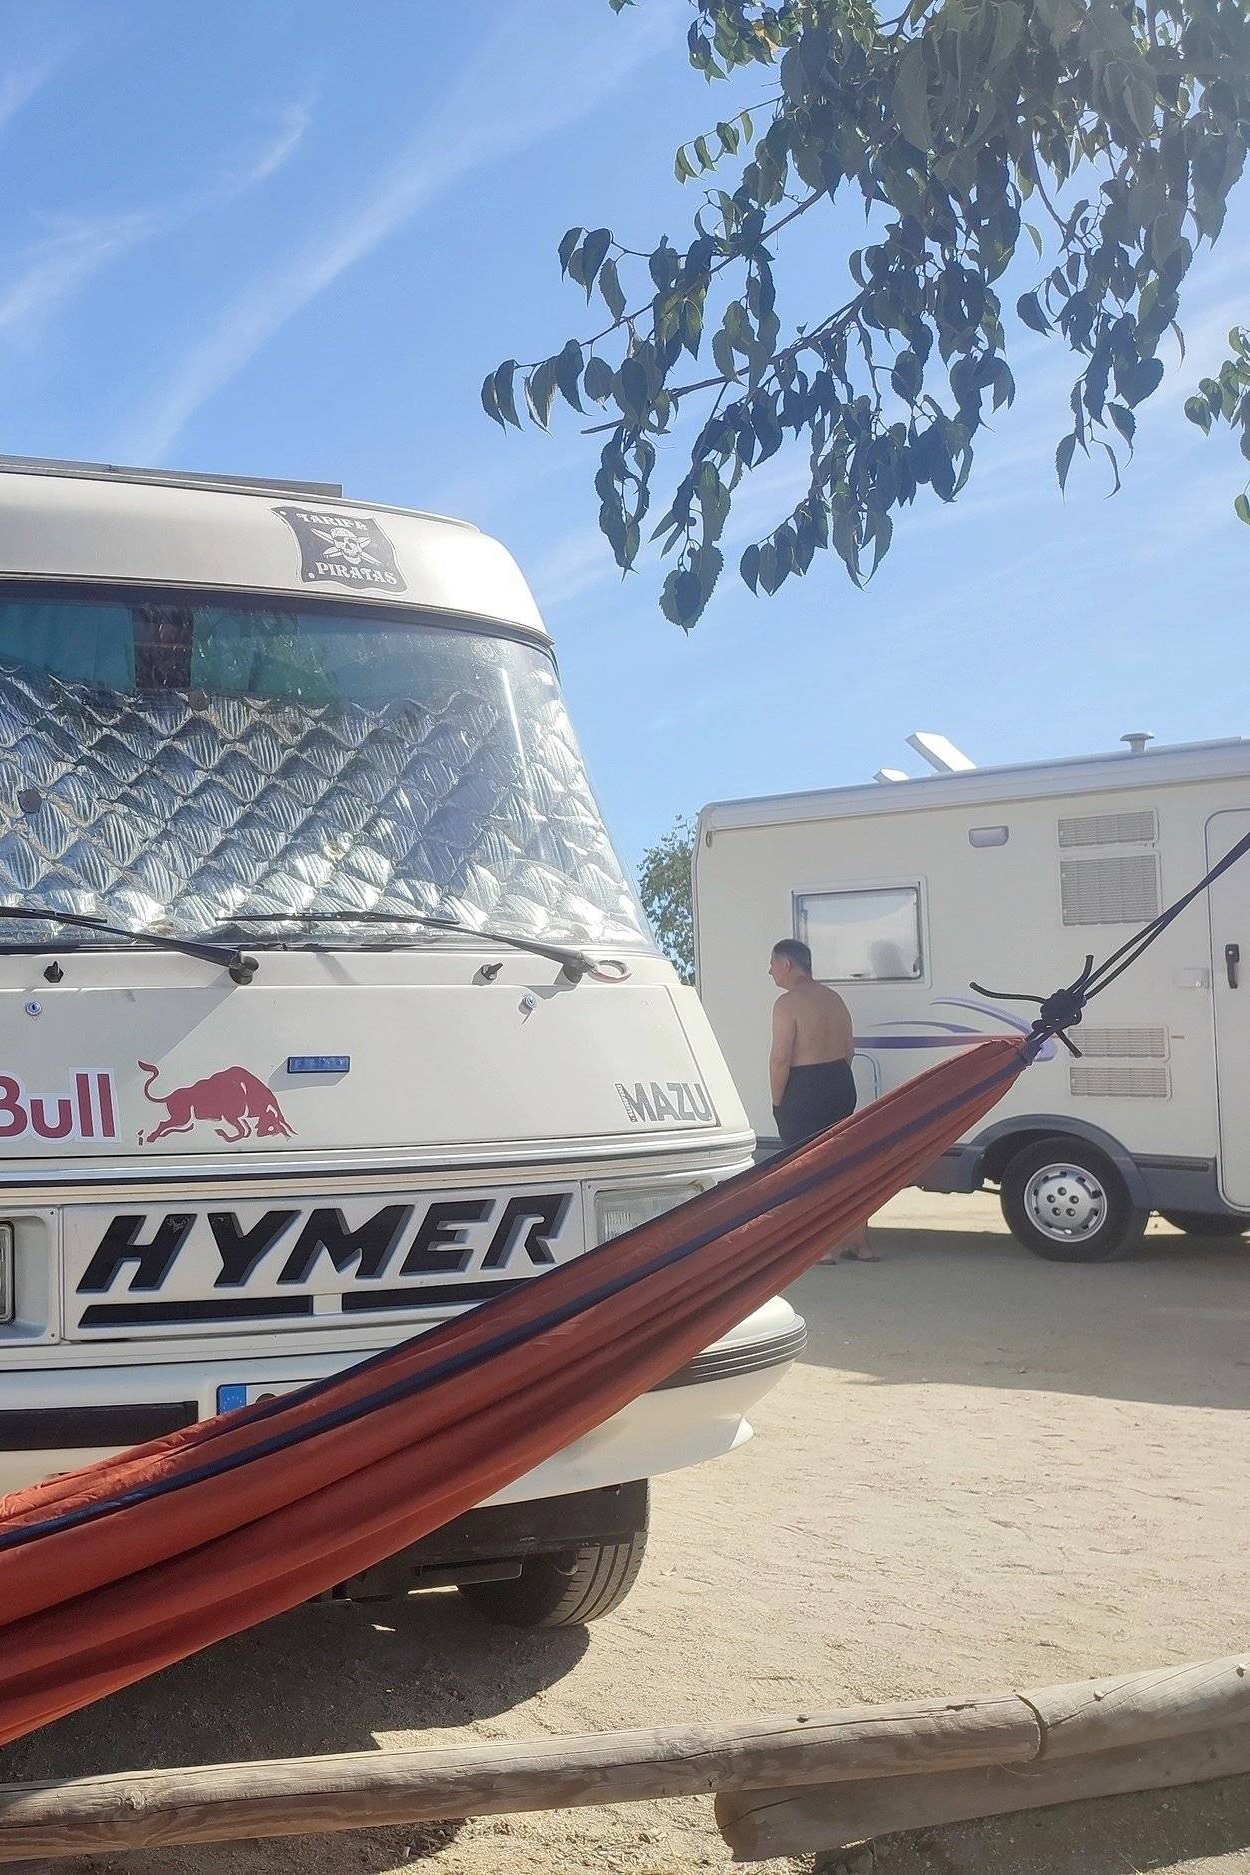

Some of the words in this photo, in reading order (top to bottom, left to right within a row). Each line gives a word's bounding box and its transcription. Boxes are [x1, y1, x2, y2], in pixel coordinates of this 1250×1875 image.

[296, 513, 368, 531] TARIFA
[315, 562, 398, 585] PIRATAS
[615, 1082, 712, 1122] MAZU
[76, 1193, 573, 1294] HYMER
